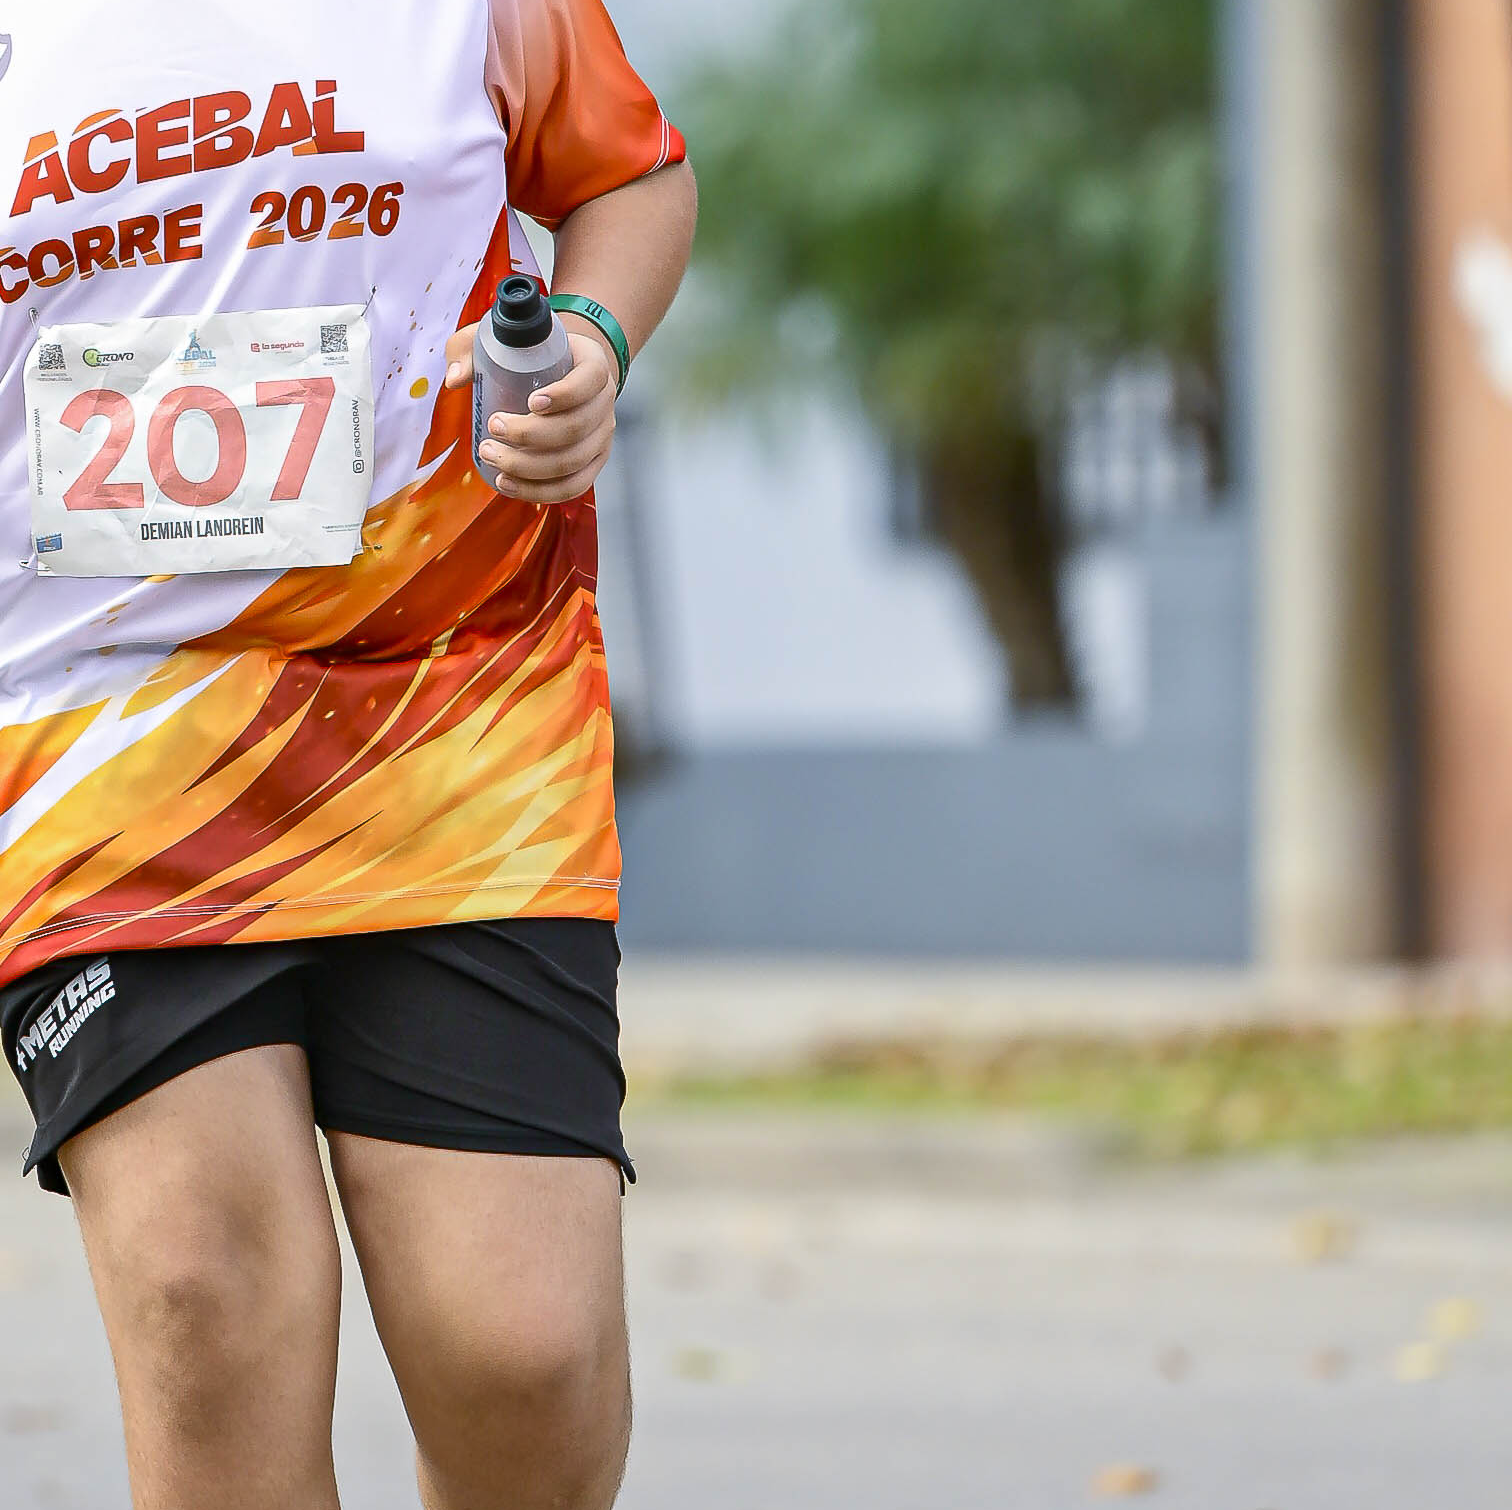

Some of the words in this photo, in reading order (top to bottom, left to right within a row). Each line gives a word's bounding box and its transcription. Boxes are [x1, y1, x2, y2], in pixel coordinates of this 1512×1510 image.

[8, 79, 365, 218] ACEBAL
[247, 181, 404, 250] 2026
[59, 376, 336, 511] 207
[140, 521, 193, 541] DEMIAN
[196, 516, 265, 538] LANDREIN
[48, 980, 117, 1059] RUNNING
